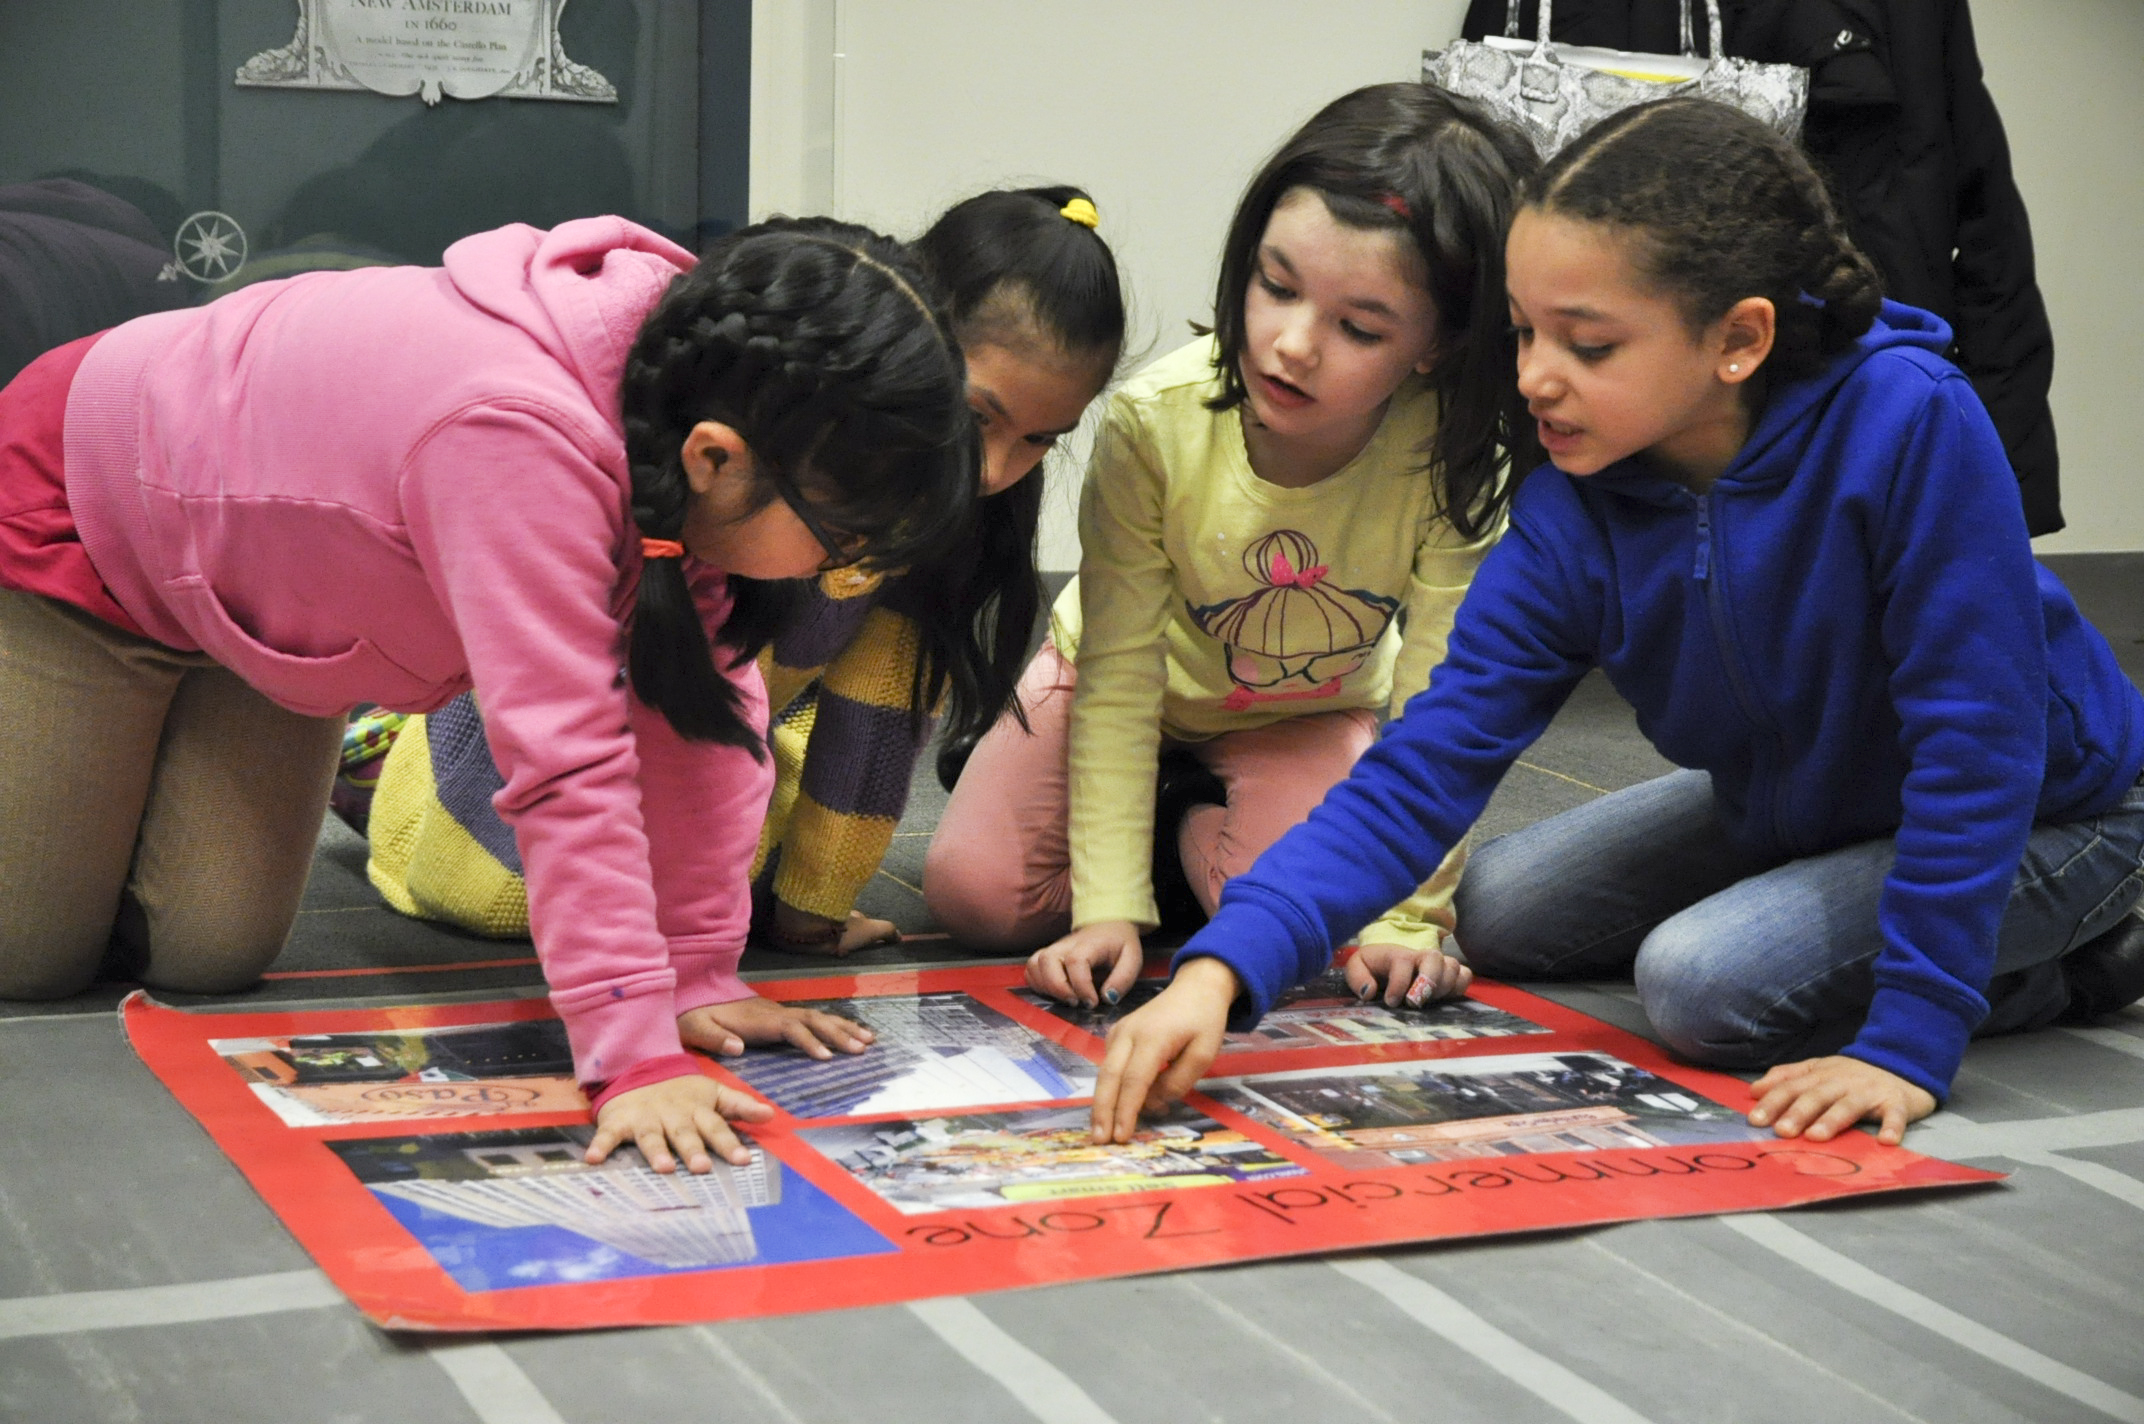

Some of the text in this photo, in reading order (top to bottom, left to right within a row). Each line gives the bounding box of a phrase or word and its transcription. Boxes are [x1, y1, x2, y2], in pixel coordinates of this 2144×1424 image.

[401, 0, 511, 16] AMSTERDAM
[405, 17, 457, 31] IN 1660
[379, 1087, 508, 1104] Paso
[895, 1147, 1863, 1247] Commercial Zone
